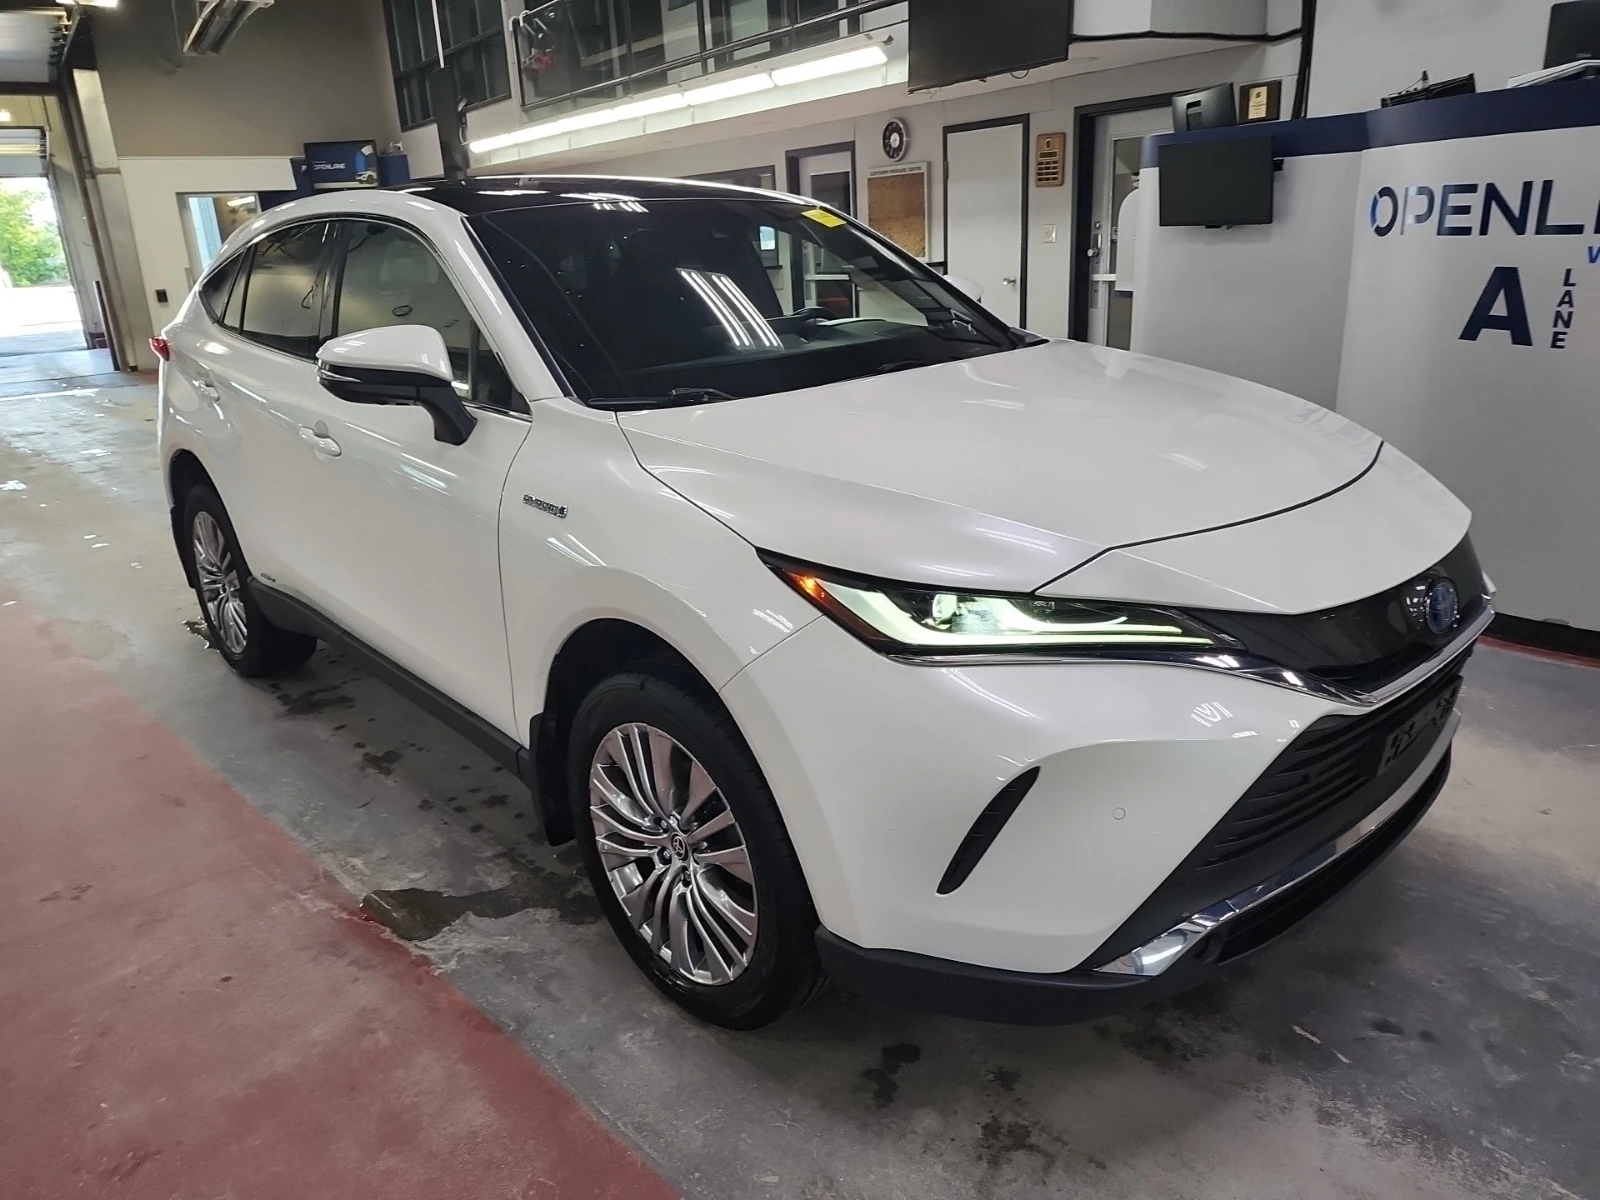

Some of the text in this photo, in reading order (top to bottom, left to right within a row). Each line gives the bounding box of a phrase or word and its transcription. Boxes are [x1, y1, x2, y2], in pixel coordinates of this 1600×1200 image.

[1370, 179, 1600, 237] OPENL
[1458, 266, 1533, 346] A
[1550, 267, 1577, 349] LANE
